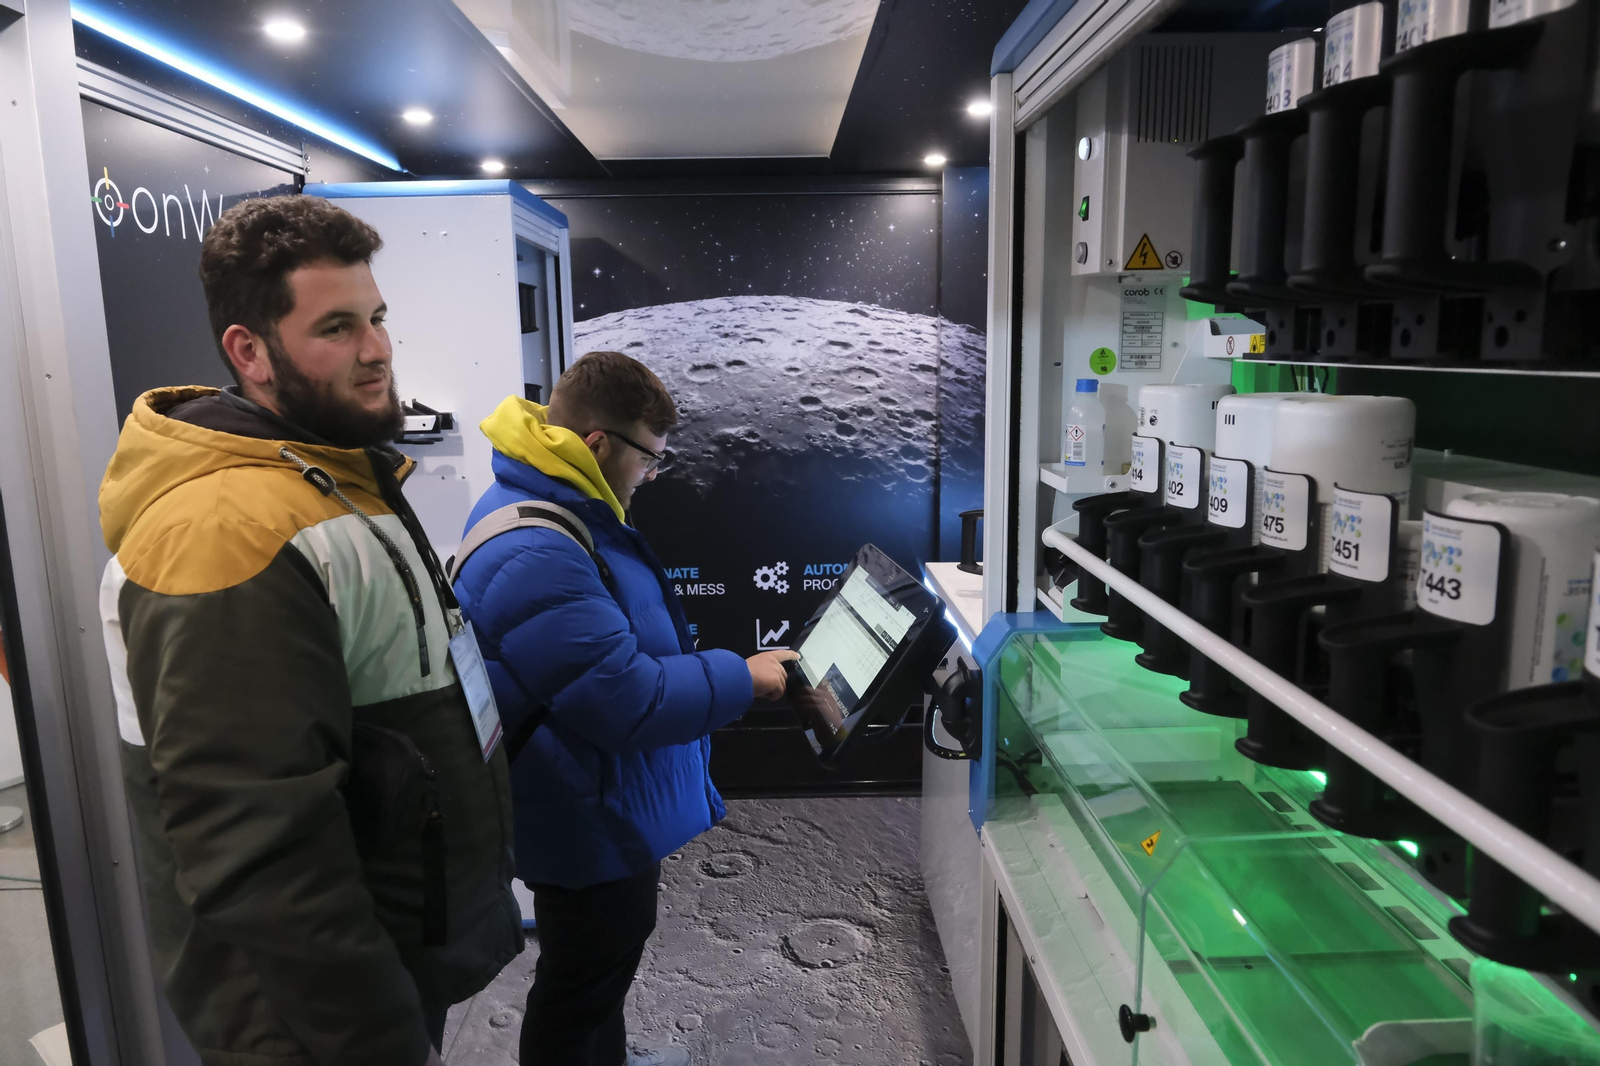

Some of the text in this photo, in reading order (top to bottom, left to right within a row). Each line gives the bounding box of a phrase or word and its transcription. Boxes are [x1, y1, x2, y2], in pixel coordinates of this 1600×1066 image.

[1124, 288, 1150, 296] corob
[663, 567, 699, 579] NATE
[803, 563, 848, 576] AUTO
[674, 584, 726, 595] & MESS
[803, 578, 839, 590] PRO
